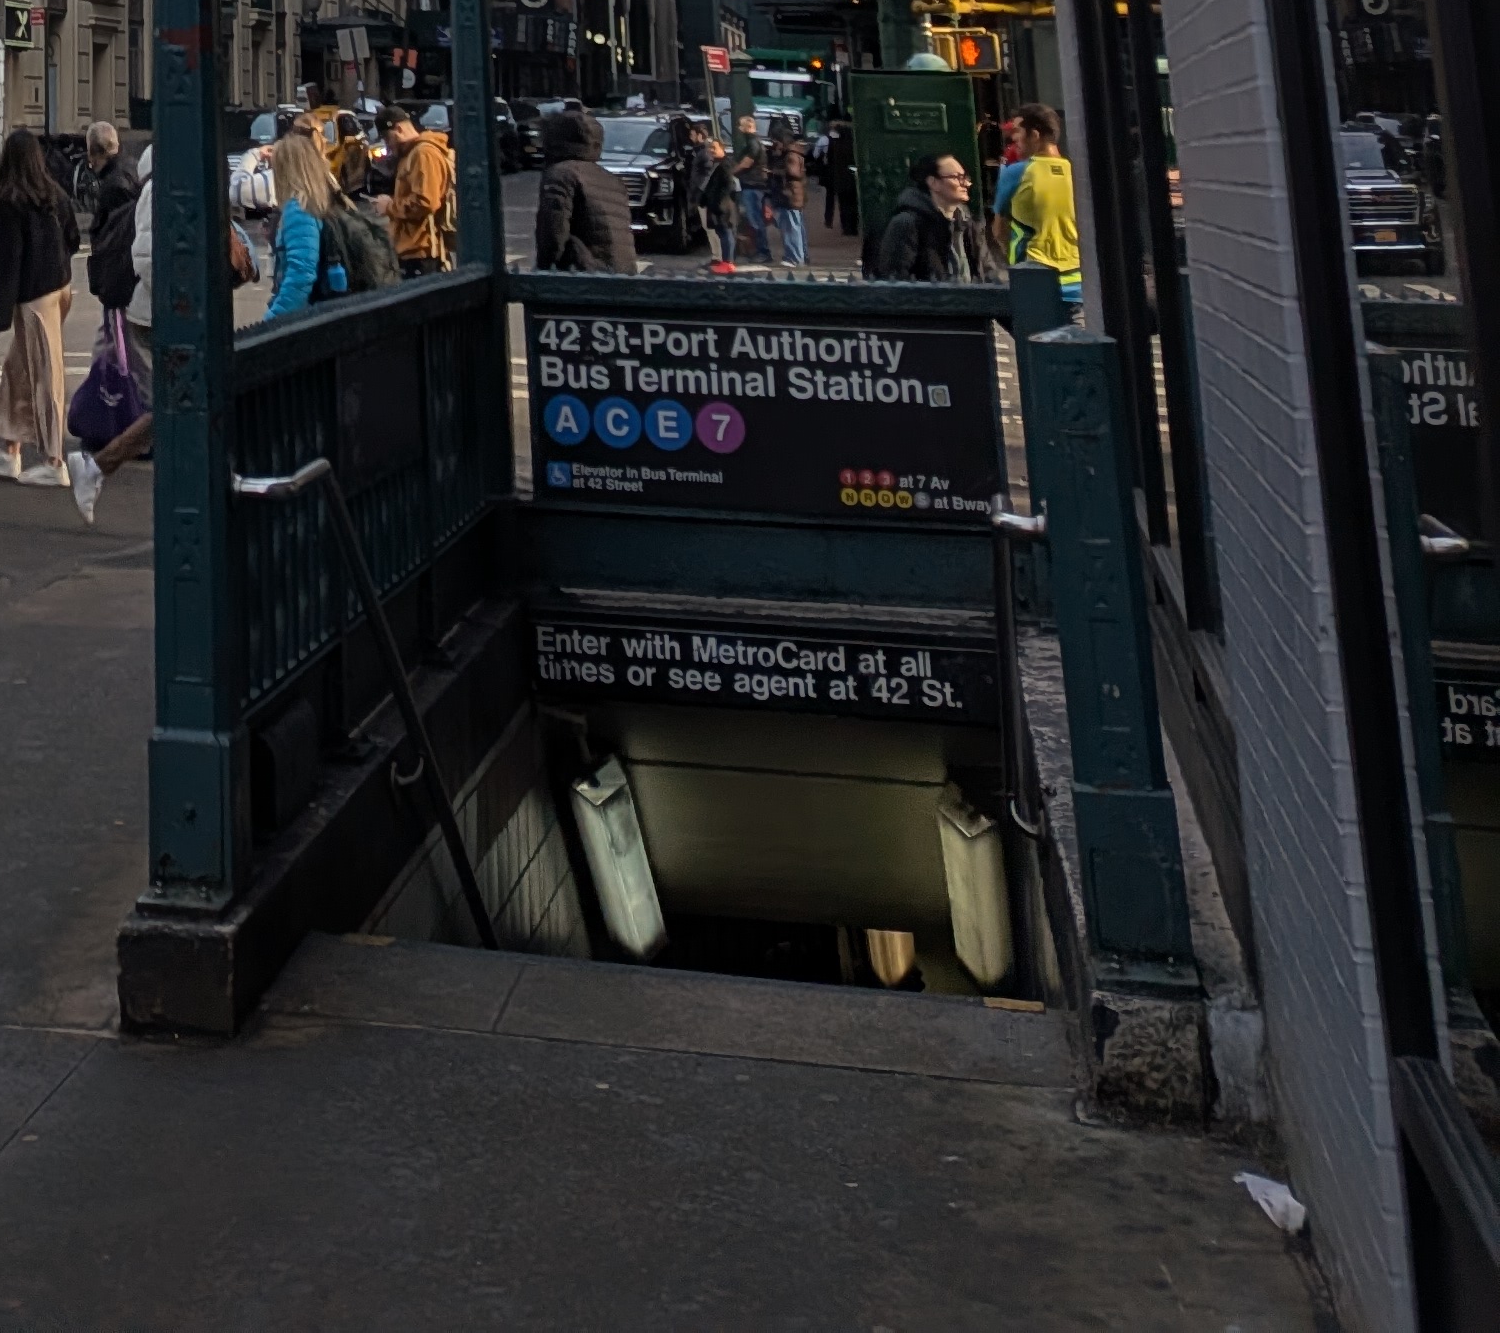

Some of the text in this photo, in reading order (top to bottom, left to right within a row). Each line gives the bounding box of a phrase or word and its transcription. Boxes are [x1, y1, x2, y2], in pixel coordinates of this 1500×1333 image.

[539, 320, 903, 373] 42 St-Port Authority
[540, 357, 924, 405] Bus Terminal Station
[555, 407, 732, 442] A C E 7
[572, 463, 622, 478] Elevator
[641, 466, 667, 480] Bus
[667, 468, 723, 484] Terminal
[572, 477, 644, 492] at 42 Street
[899, 475, 914, 489] at
[916, 475, 926, 489] 7
[930, 476, 950, 490] Av
[934, 496, 950, 509] at
[952, 496, 992, 514] Bway
[537, 626, 932, 677] Enter with MetroCard at all
[538, 658, 963, 709] times or see agent at 42 St.
